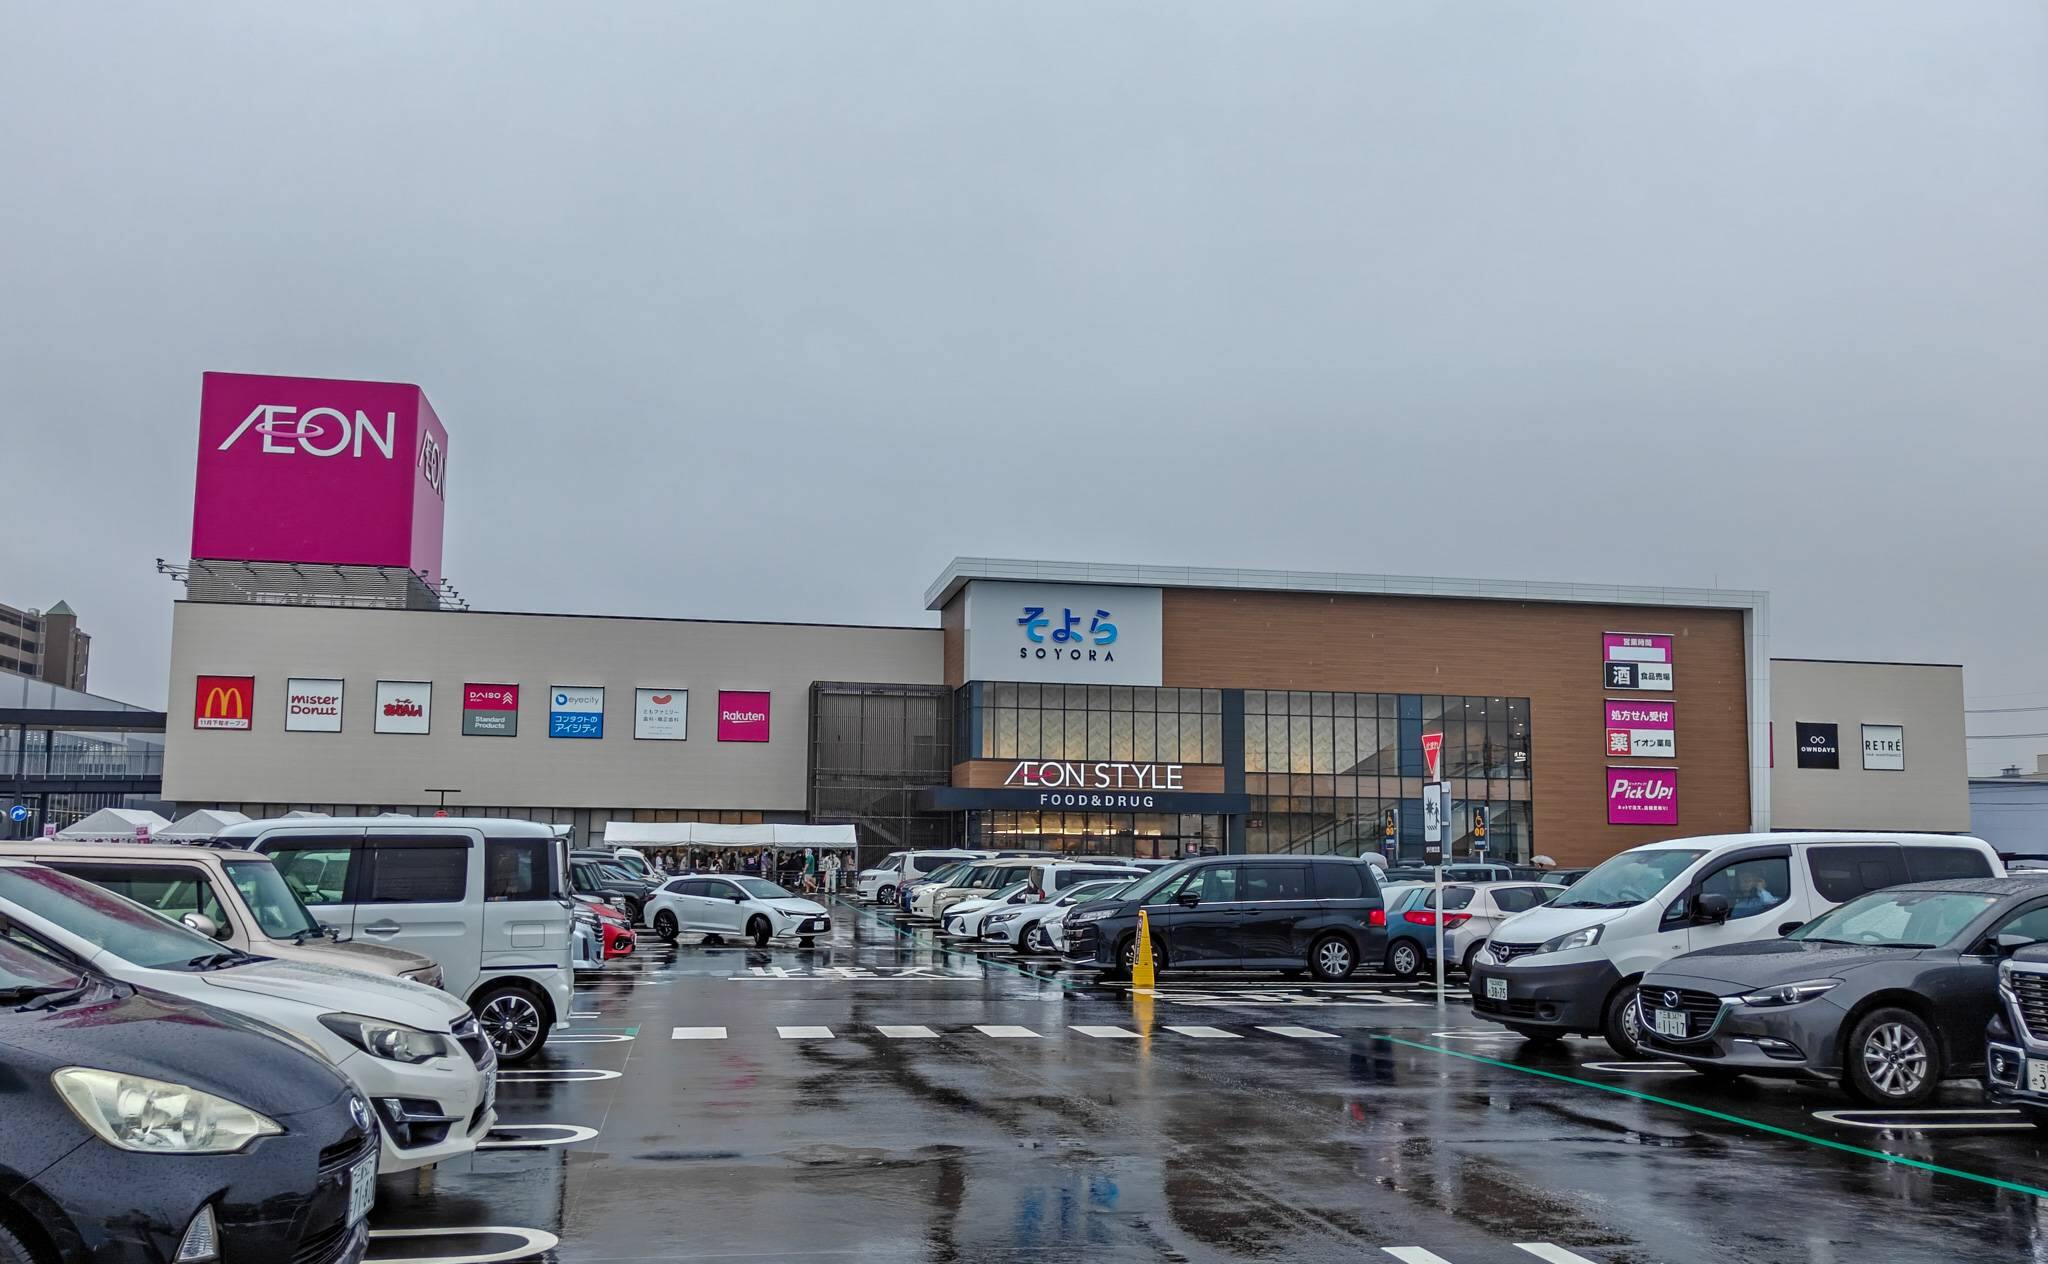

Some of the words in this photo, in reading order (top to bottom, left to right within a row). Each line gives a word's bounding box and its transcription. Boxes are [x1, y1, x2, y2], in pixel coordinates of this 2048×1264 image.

[1017, 606, 1118, 646] そよら
[1020, 647, 1114, 662] SOYORA
[1613, 666, 1631, 684] 酒
[290, 705, 338, 716] Donut
[723, 710, 765, 721] Rakuten
[1611, 710, 1668, 722] 処方せん受付
[555, 715, 598, 723] コンタクトの
[555, 724, 597, 733] アイシティ
[1610, 732, 1628, 751] 薬
[1634, 739, 1672, 747] イオン薬局
[1865, 739, 1901, 751] RETRÉ
[1095, 763, 1184, 790] STYLE
[1041, 794, 1154, 807] FOOD&DRUG
